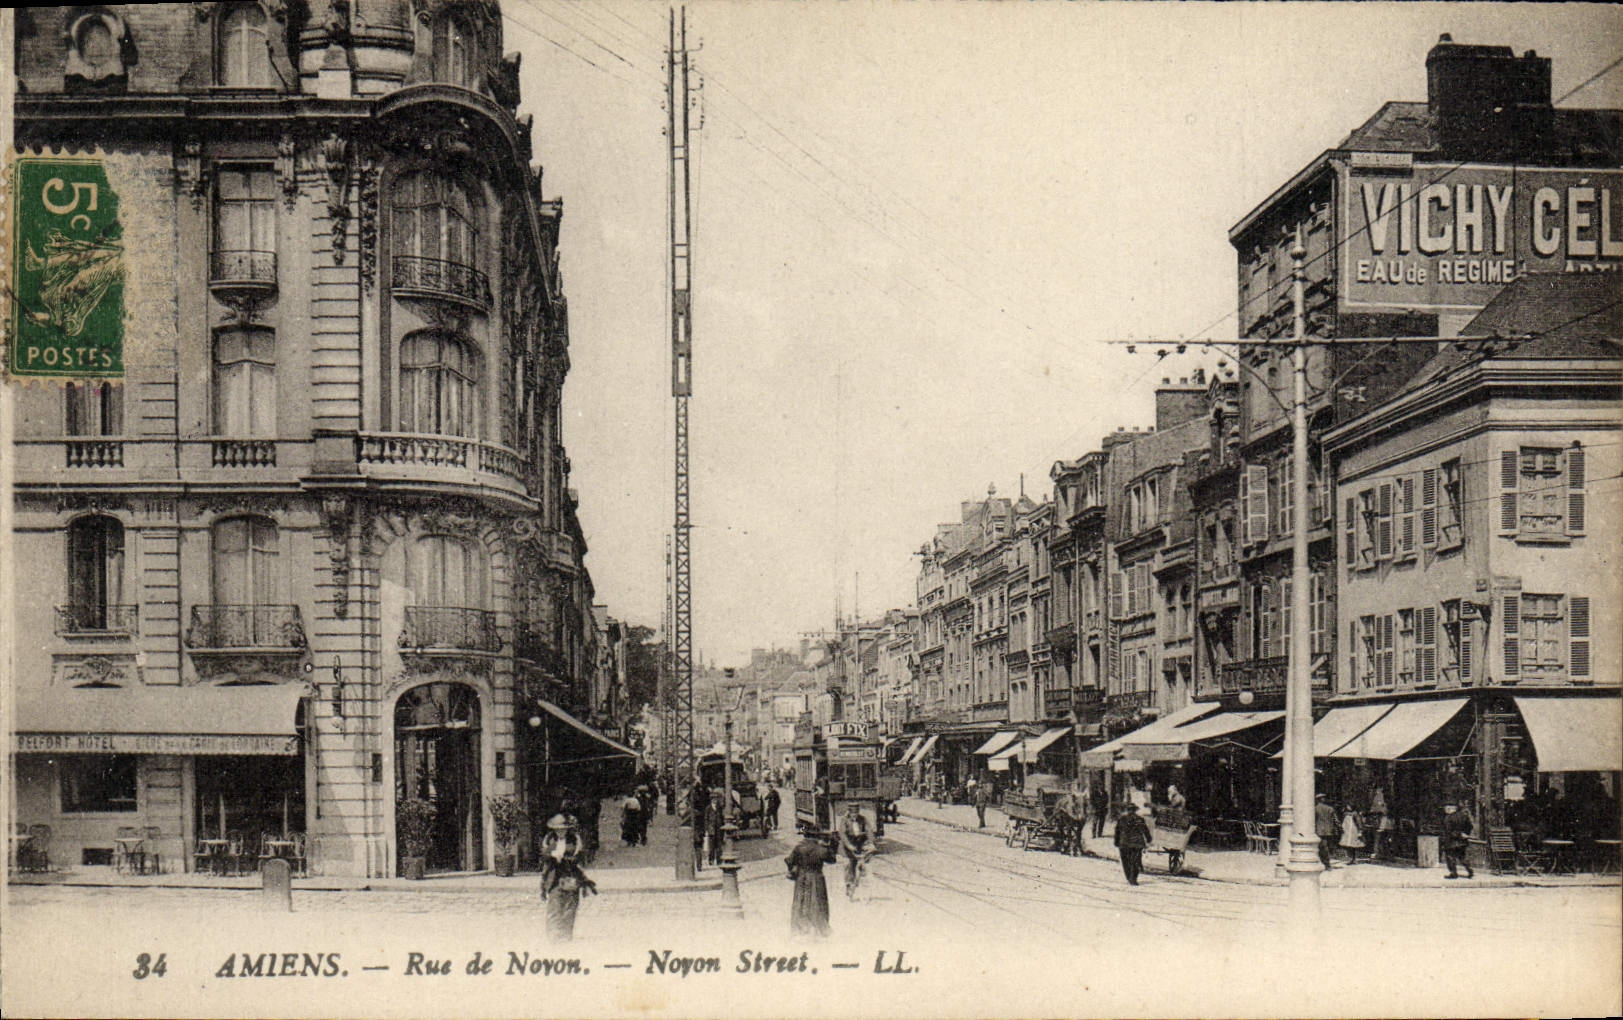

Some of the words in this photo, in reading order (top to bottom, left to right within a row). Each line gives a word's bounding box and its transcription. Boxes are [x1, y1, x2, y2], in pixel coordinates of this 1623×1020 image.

[1361, 183, 1513, 253] VICHY
[1533, 178, 1622, 257] CÉL
[1357, 260, 1403, 283] EAU
[1406, 262, 1427, 283] de
[1438, 256, 1515, 284] RÉGIME
[27, 346, 113, 367] POSTES
